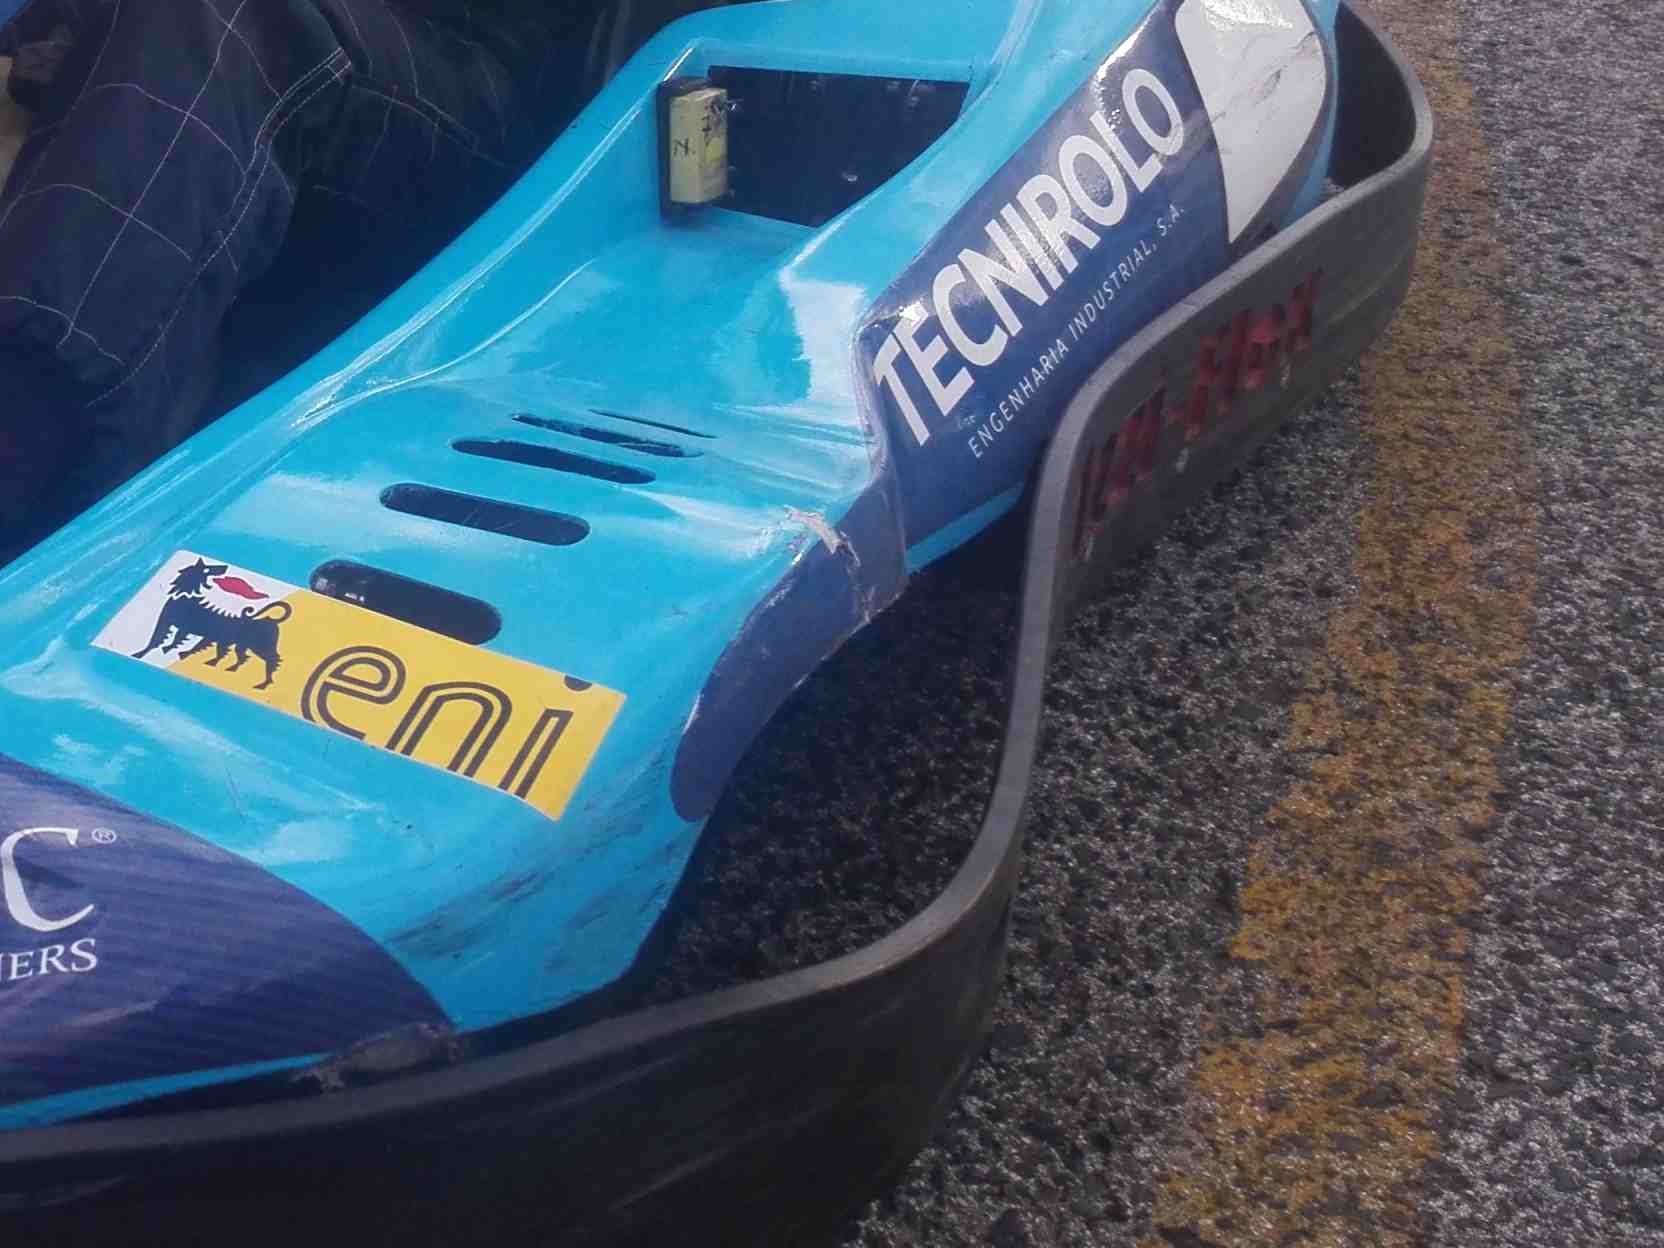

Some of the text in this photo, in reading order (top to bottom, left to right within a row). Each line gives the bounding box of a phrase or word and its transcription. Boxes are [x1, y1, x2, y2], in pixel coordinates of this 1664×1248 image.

[872, 68, 1184, 446] TECNIROLO
[968, 338, 1069, 458] ENGENHARIA
[300, 645, 594, 799] eni
